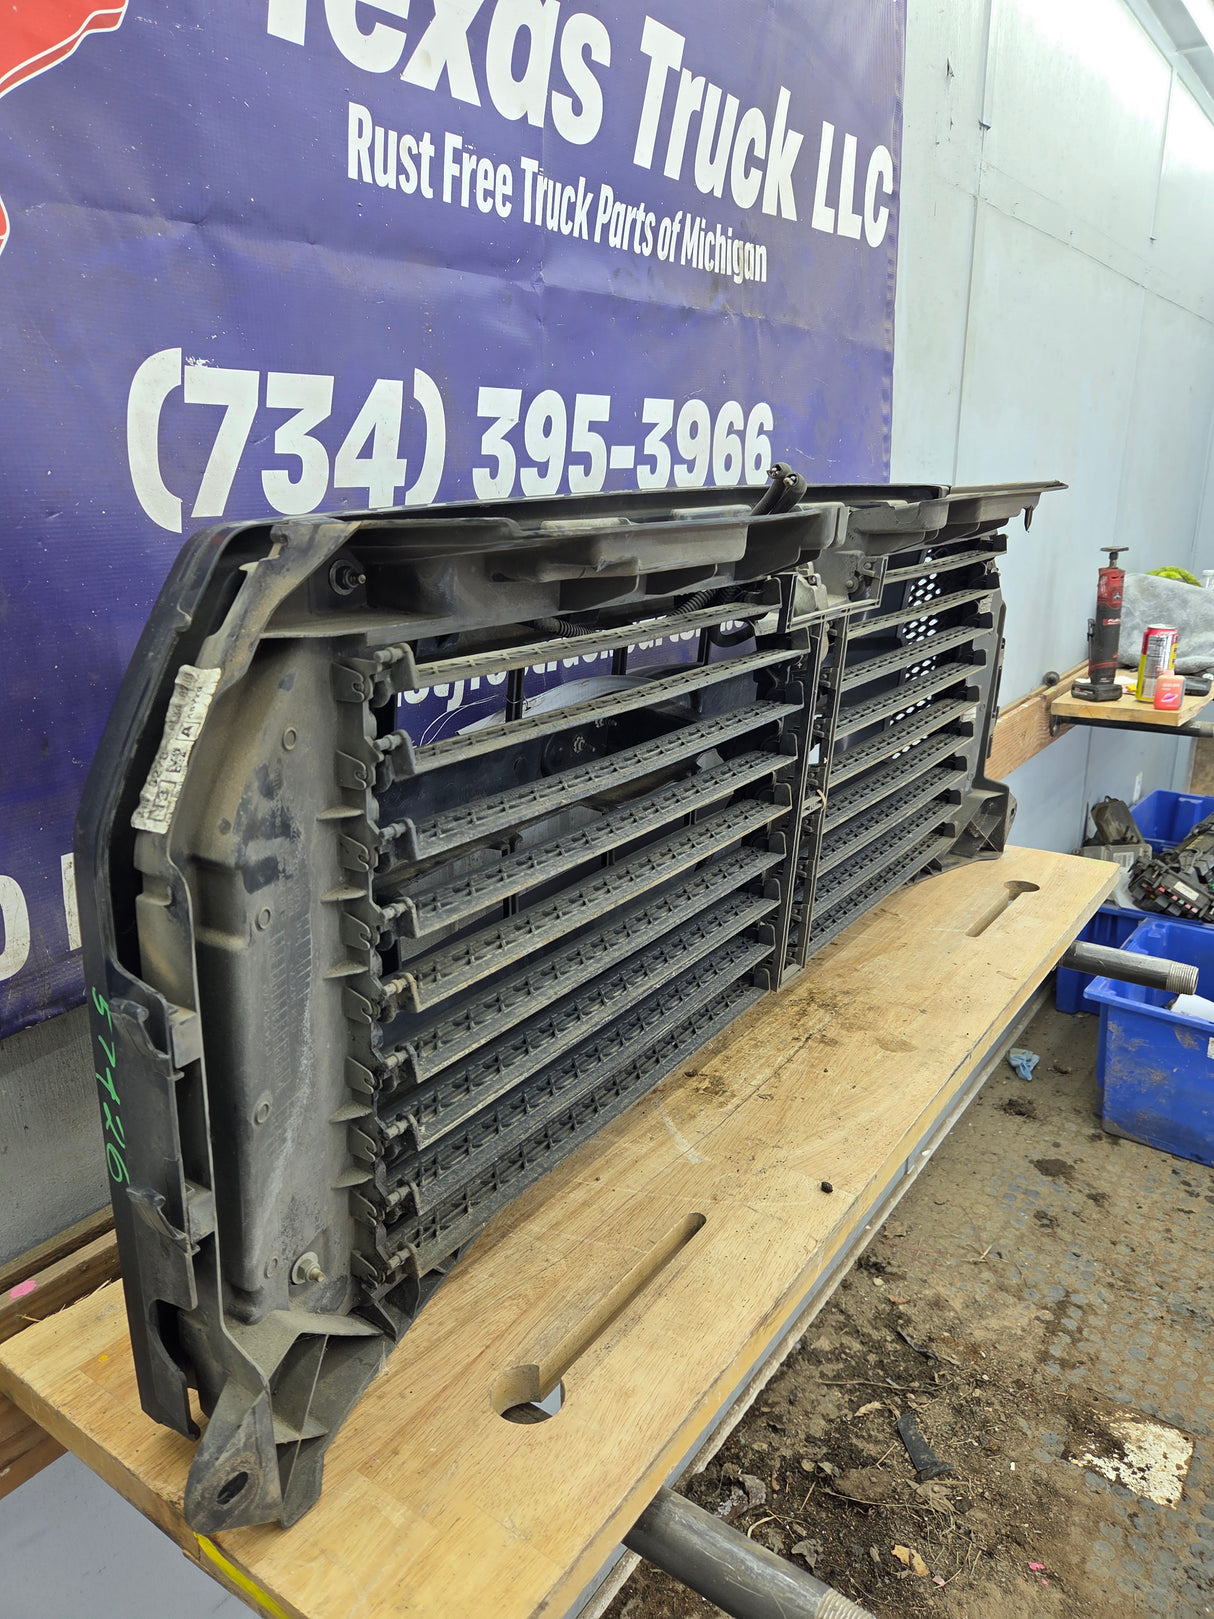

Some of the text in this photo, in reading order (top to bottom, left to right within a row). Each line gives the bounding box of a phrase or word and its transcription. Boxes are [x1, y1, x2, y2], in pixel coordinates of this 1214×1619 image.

[267, 0, 894, 249] exas Truck LLC
[348, 101, 768, 285] Rust Free Truck Parts of Michigan
[127, 347, 775, 533] (734) 395-3966
